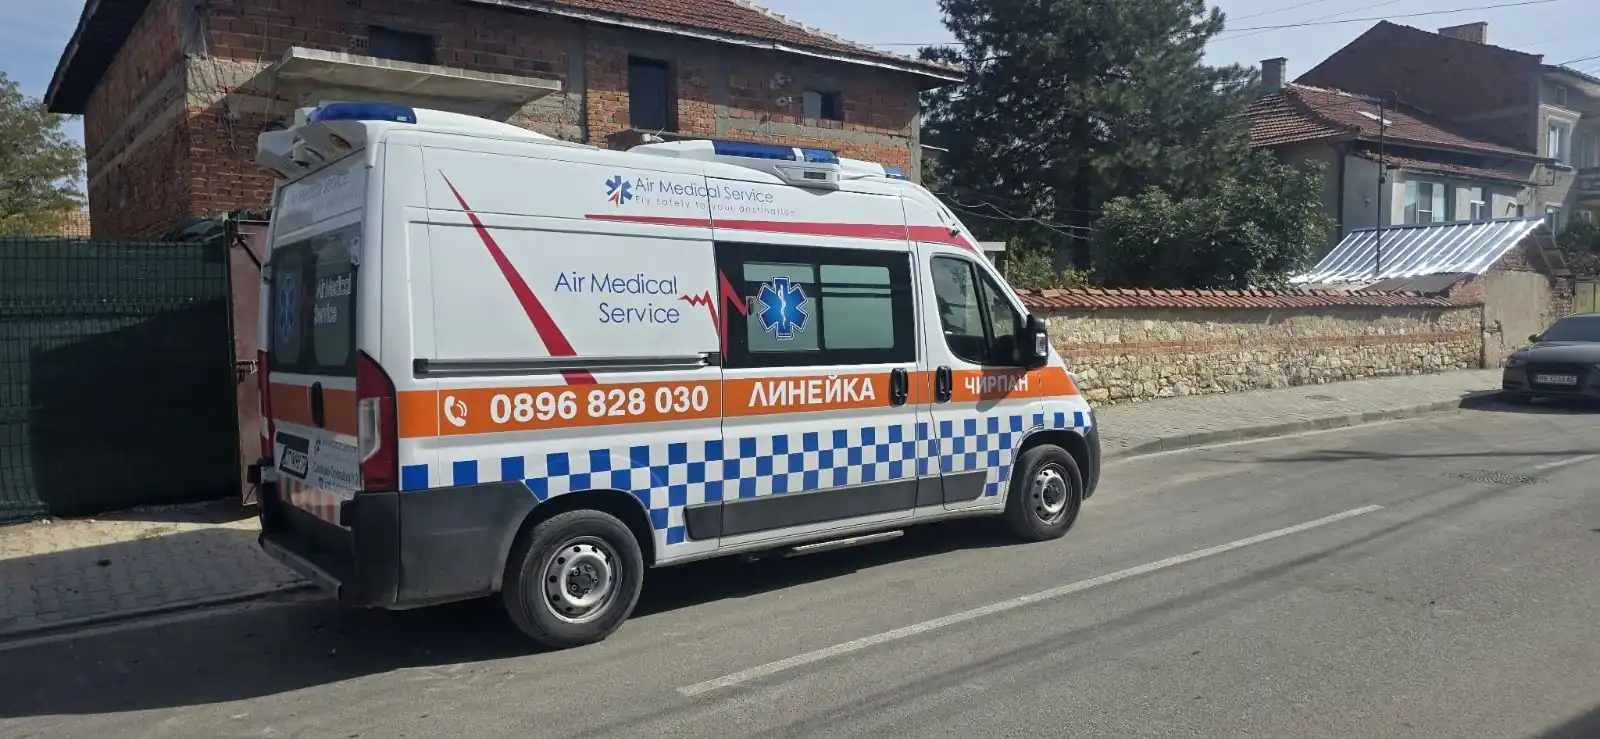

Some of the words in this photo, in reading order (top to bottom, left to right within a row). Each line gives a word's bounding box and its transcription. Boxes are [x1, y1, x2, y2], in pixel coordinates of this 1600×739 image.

[635, 177, 655, 192] Air
[659, 180, 720, 199] Medical
[724, 186, 774, 204] Service
[656, 198, 690, 209] safely
[694, 200, 705, 209] to
[712, 203, 734, 213] your
[326, 272, 352, 297] Medical
[554, 271, 586, 293] Air
[590, 272, 678, 295] Medical
[599, 302, 680, 324] Service
[748, 373, 875, 408] ЛИНЕЙКА
[964, 374, 1029, 395] ЧИРПАН
[490, 391, 578, 424] 0896
[588, 388, 647, 417] 828
[655, 385, 709, 413] 030
